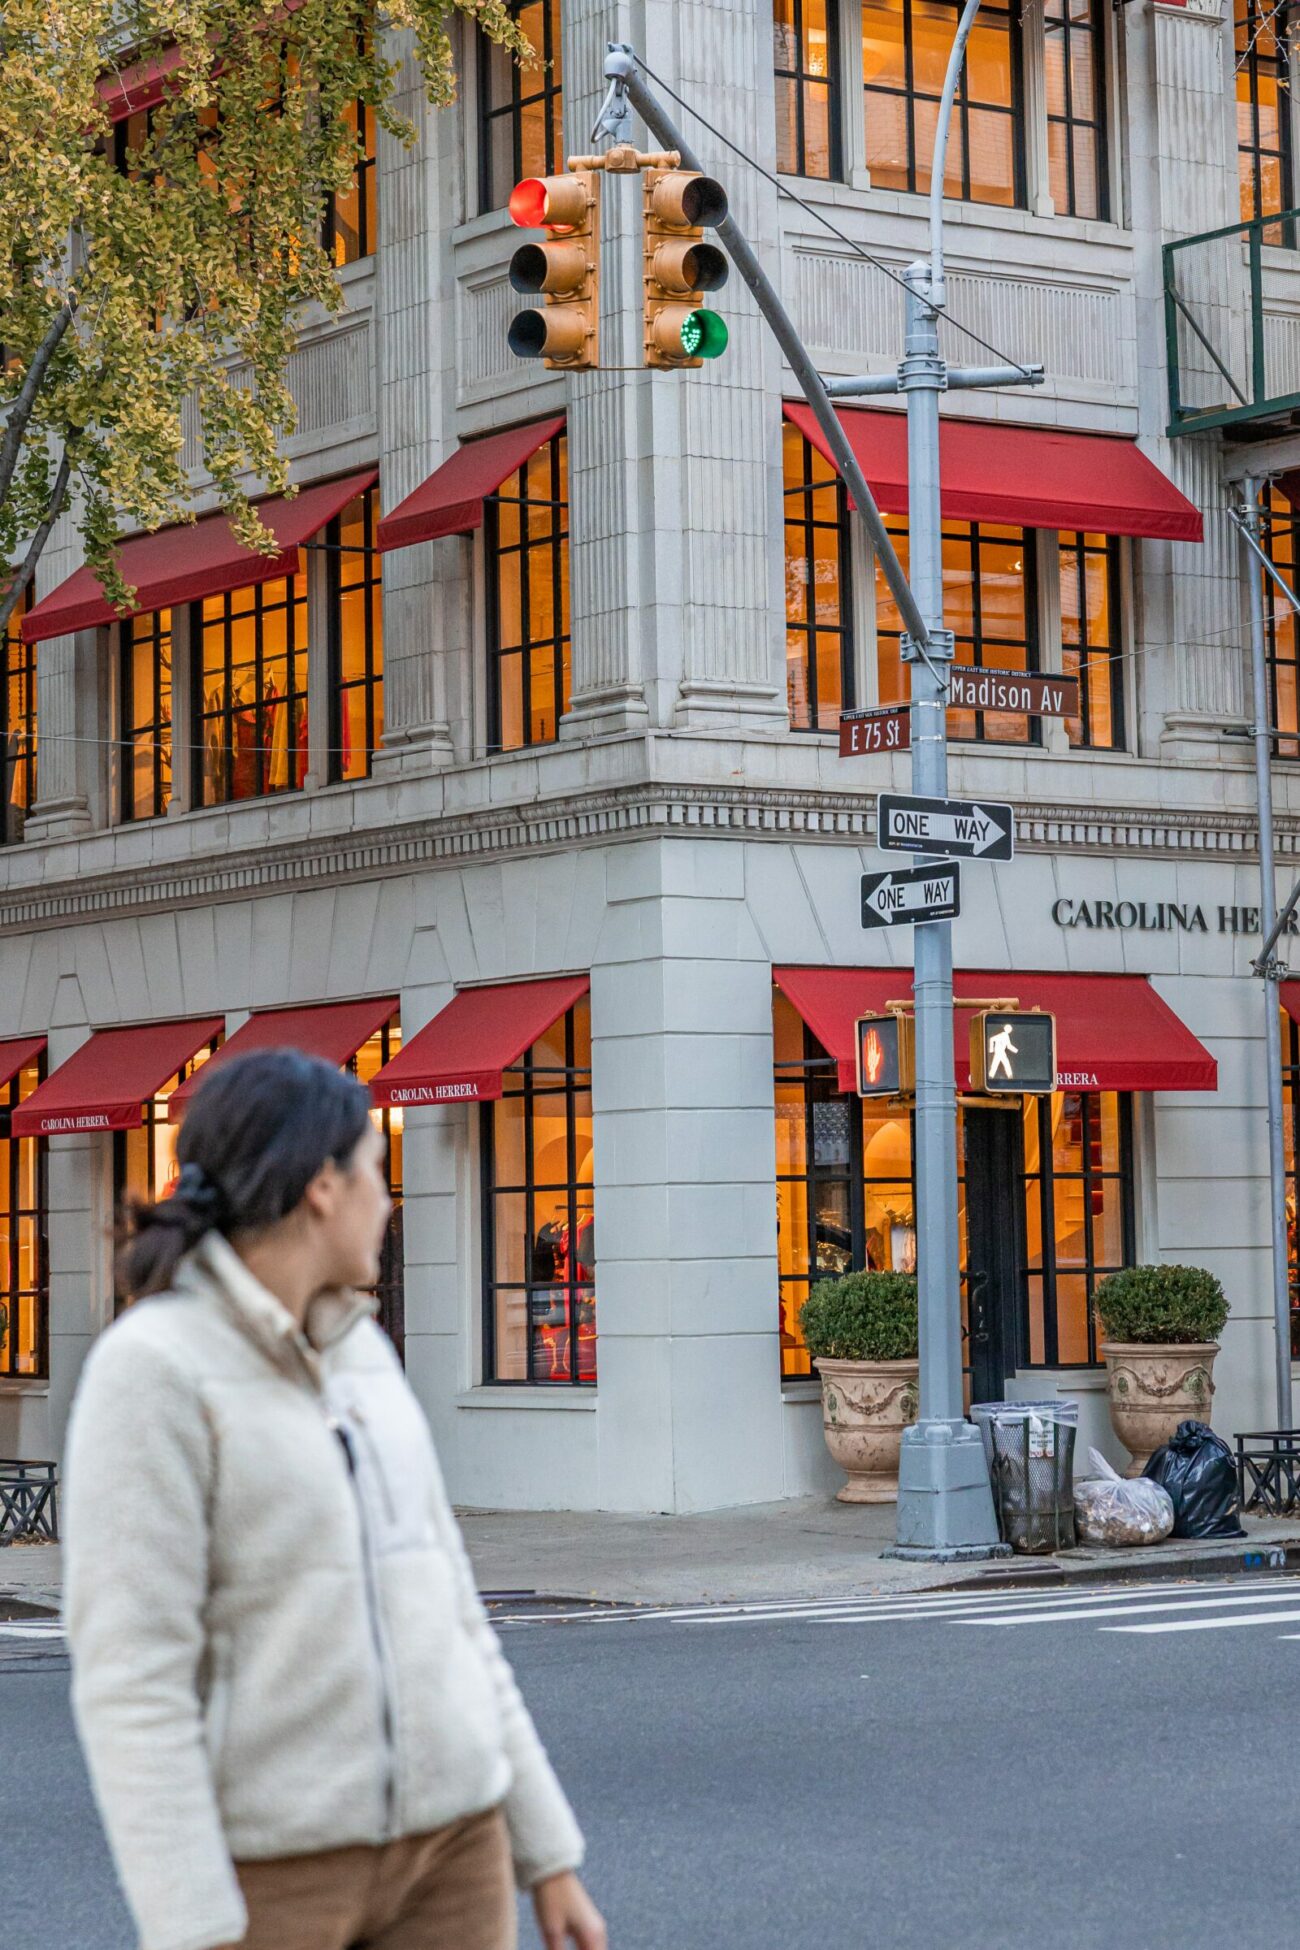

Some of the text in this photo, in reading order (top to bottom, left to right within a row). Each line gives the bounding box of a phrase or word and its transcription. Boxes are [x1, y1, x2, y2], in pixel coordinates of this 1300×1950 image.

[951, 676, 1062, 712] Madison Av
[851, 719, 900, 751] E 75 St
[893, 812, 990, 842] ONE WAY
[877, 880, 950, 910] ONE WAY
[1051, 898, 1300, 936] CAROLINA HER
[390, 1083, 479, 1102] CAROLINA HERRERA
[1056, 1072, 1099, 1086] RRERA
[41, 1114, 110, 1131] CAROLINA HERRERA
